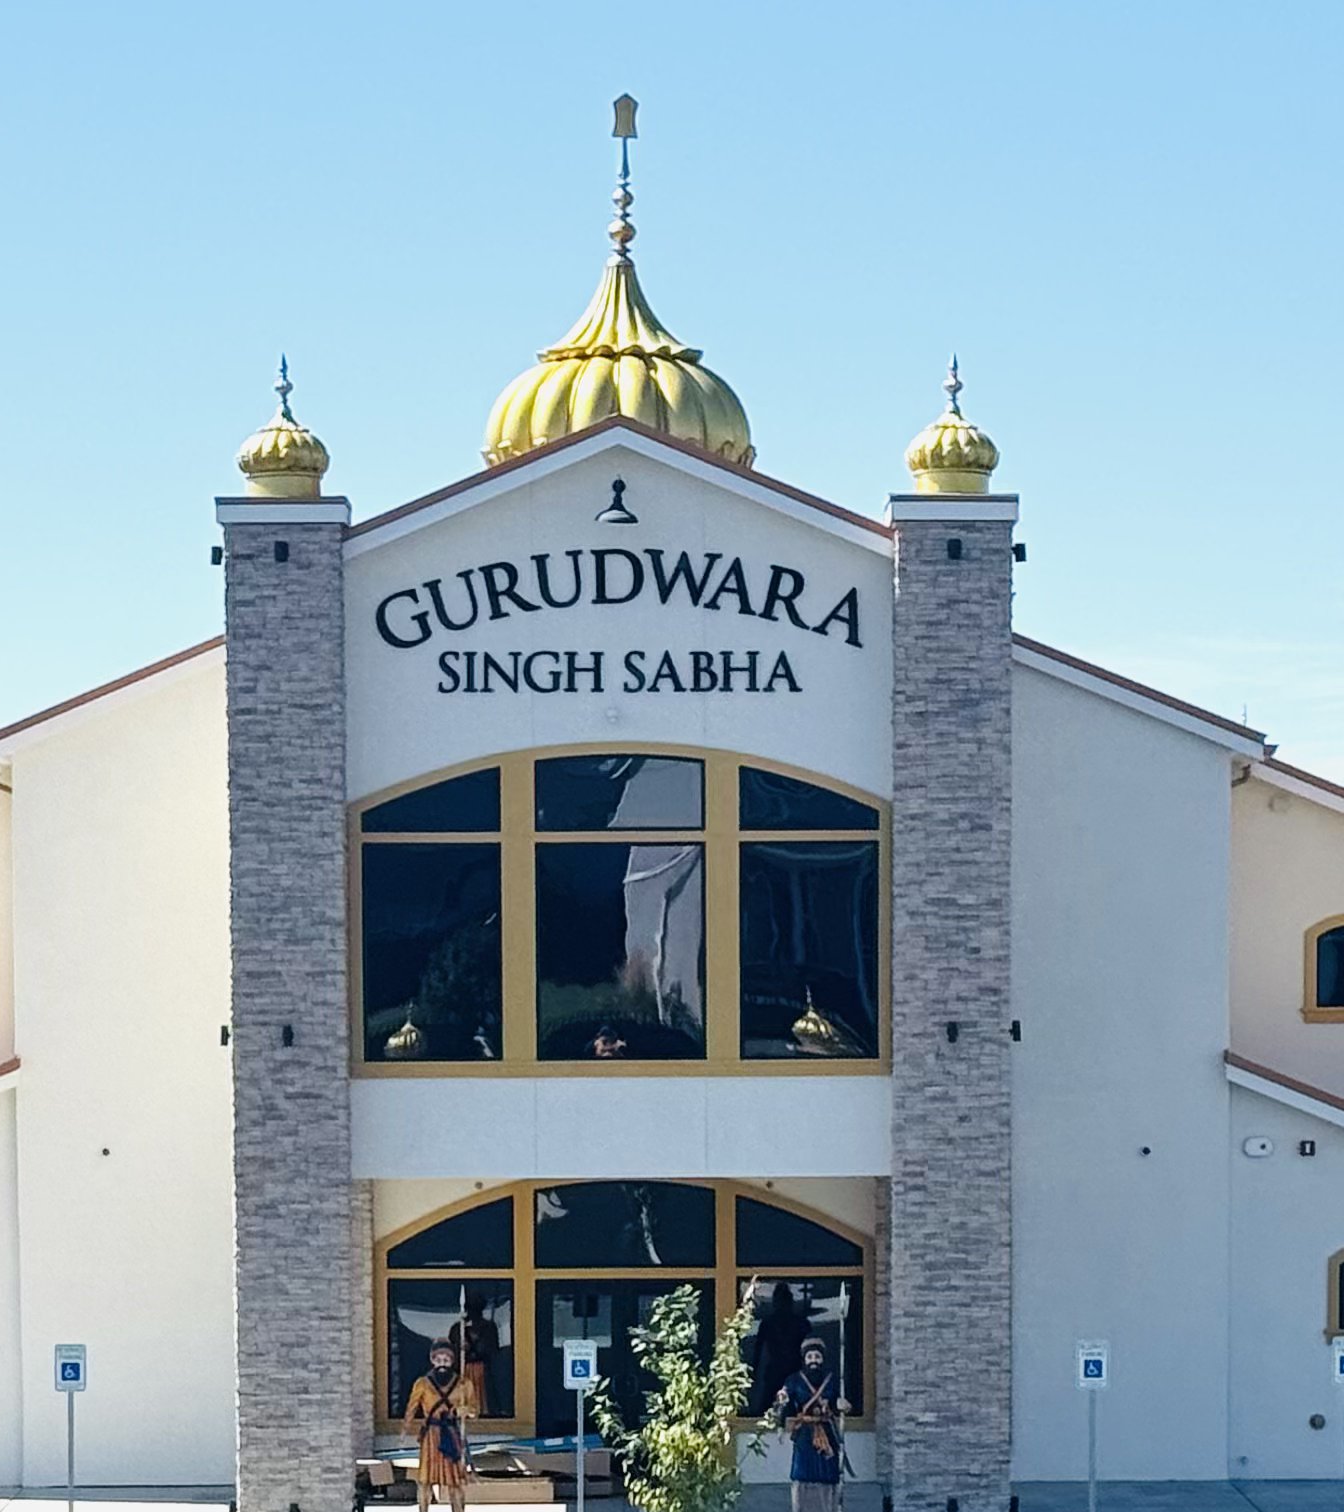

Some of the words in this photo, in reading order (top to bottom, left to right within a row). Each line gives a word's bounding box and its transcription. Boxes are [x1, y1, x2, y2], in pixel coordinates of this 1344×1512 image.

[374, 548, 864, 649] GURUDWARA
[437, 650, 605, 694] SINGH
[623, 649, 803, 693] SABHA
